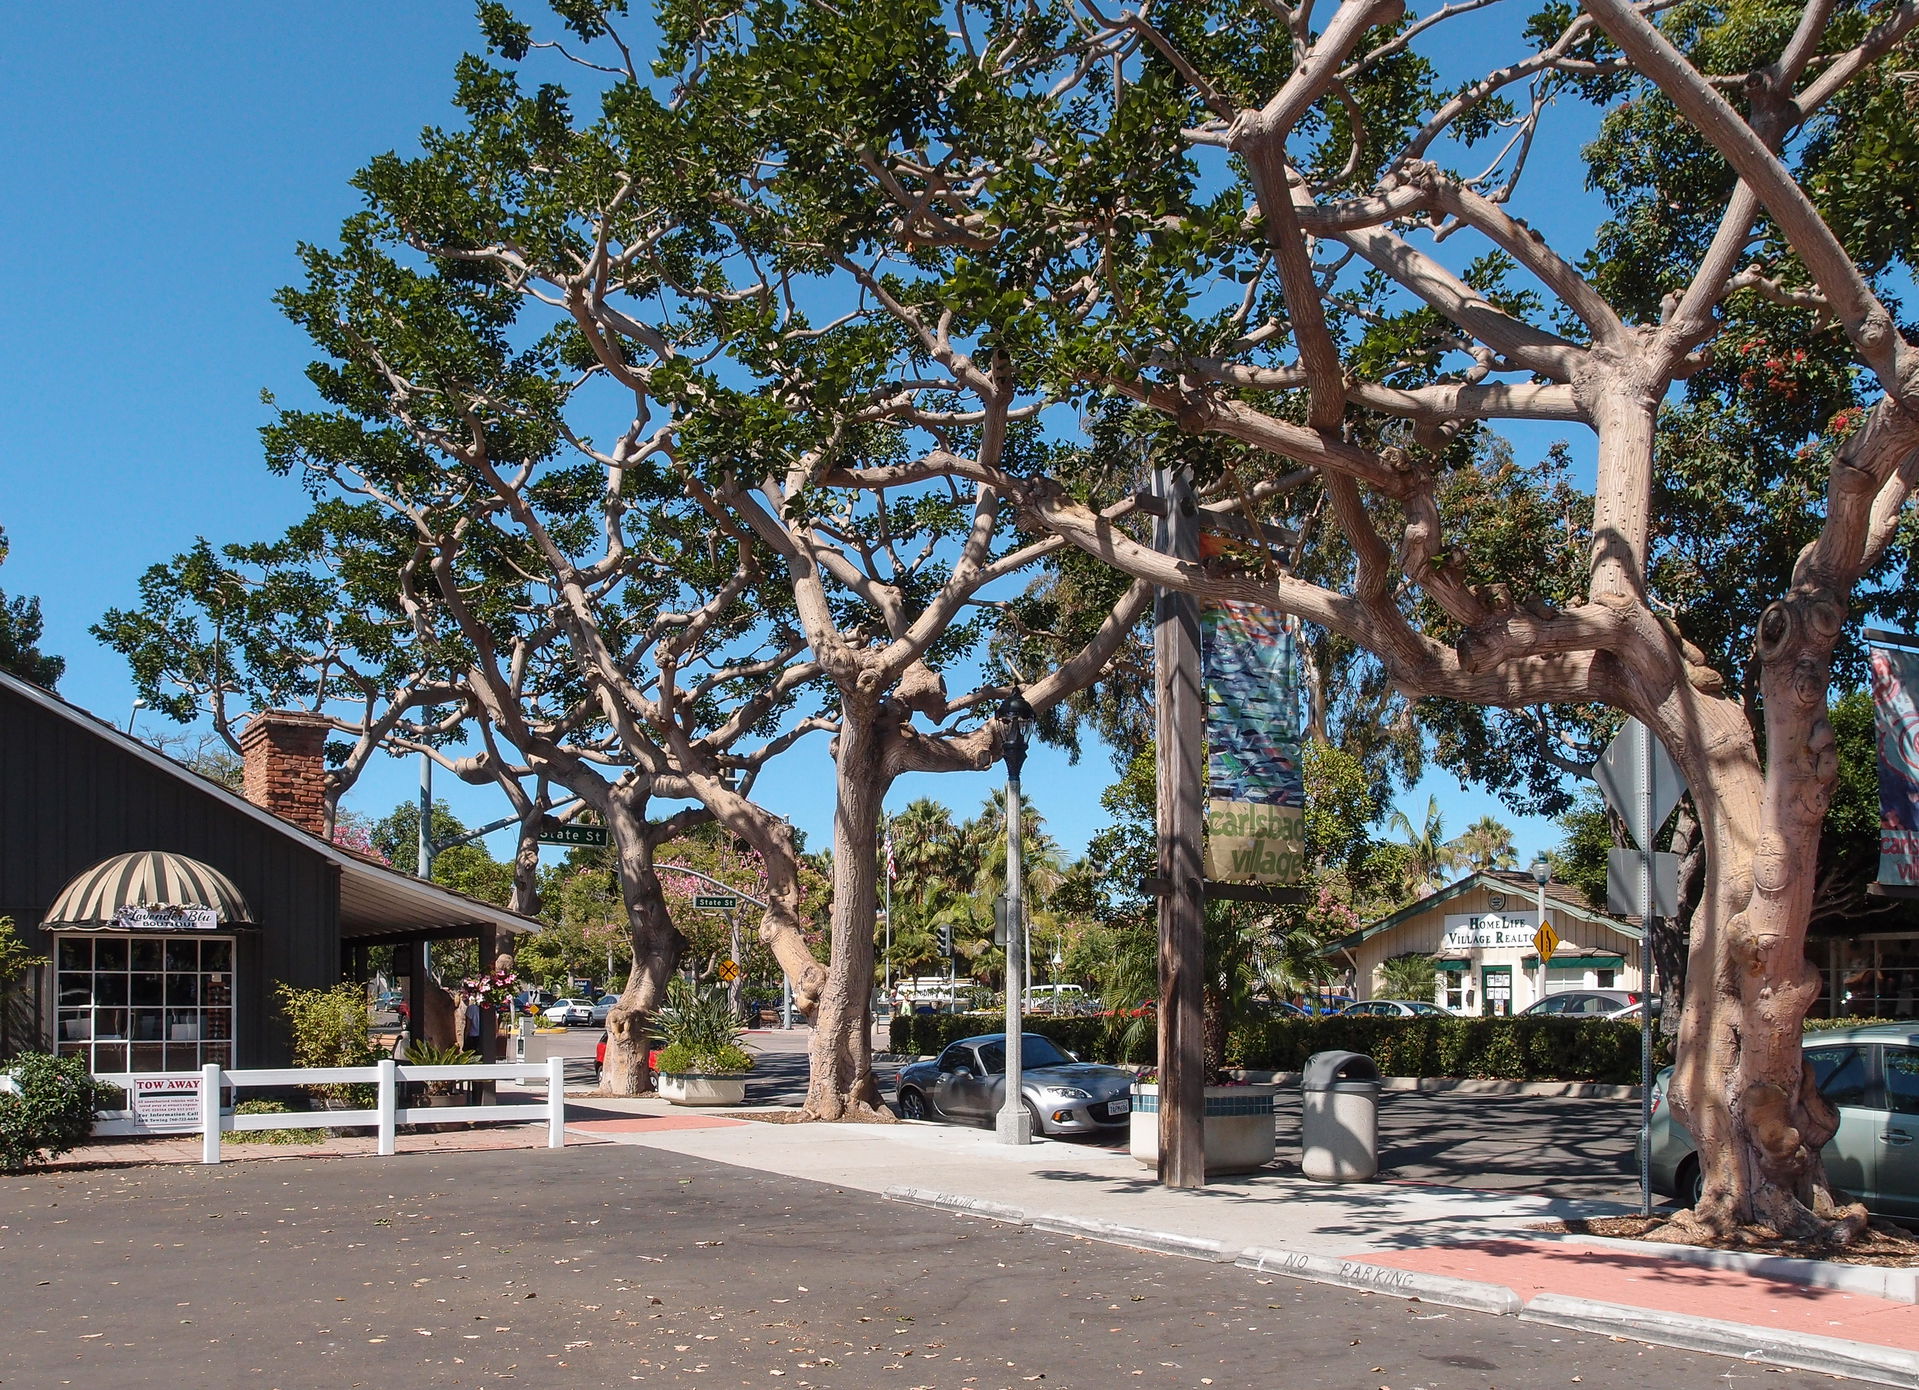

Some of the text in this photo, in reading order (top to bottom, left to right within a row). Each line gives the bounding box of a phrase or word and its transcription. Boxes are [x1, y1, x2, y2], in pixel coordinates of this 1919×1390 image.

[585, 831, 600, 842] St
[1231, 840, 1303, 881] village
[187, 910, 211, 922] Blu
[1448, 932, 1491, 945] VILLAGE
[136, 1080, 200, 1090] TOW AWAY
[1284, 1253, 1414, 1287] NO PARKING
